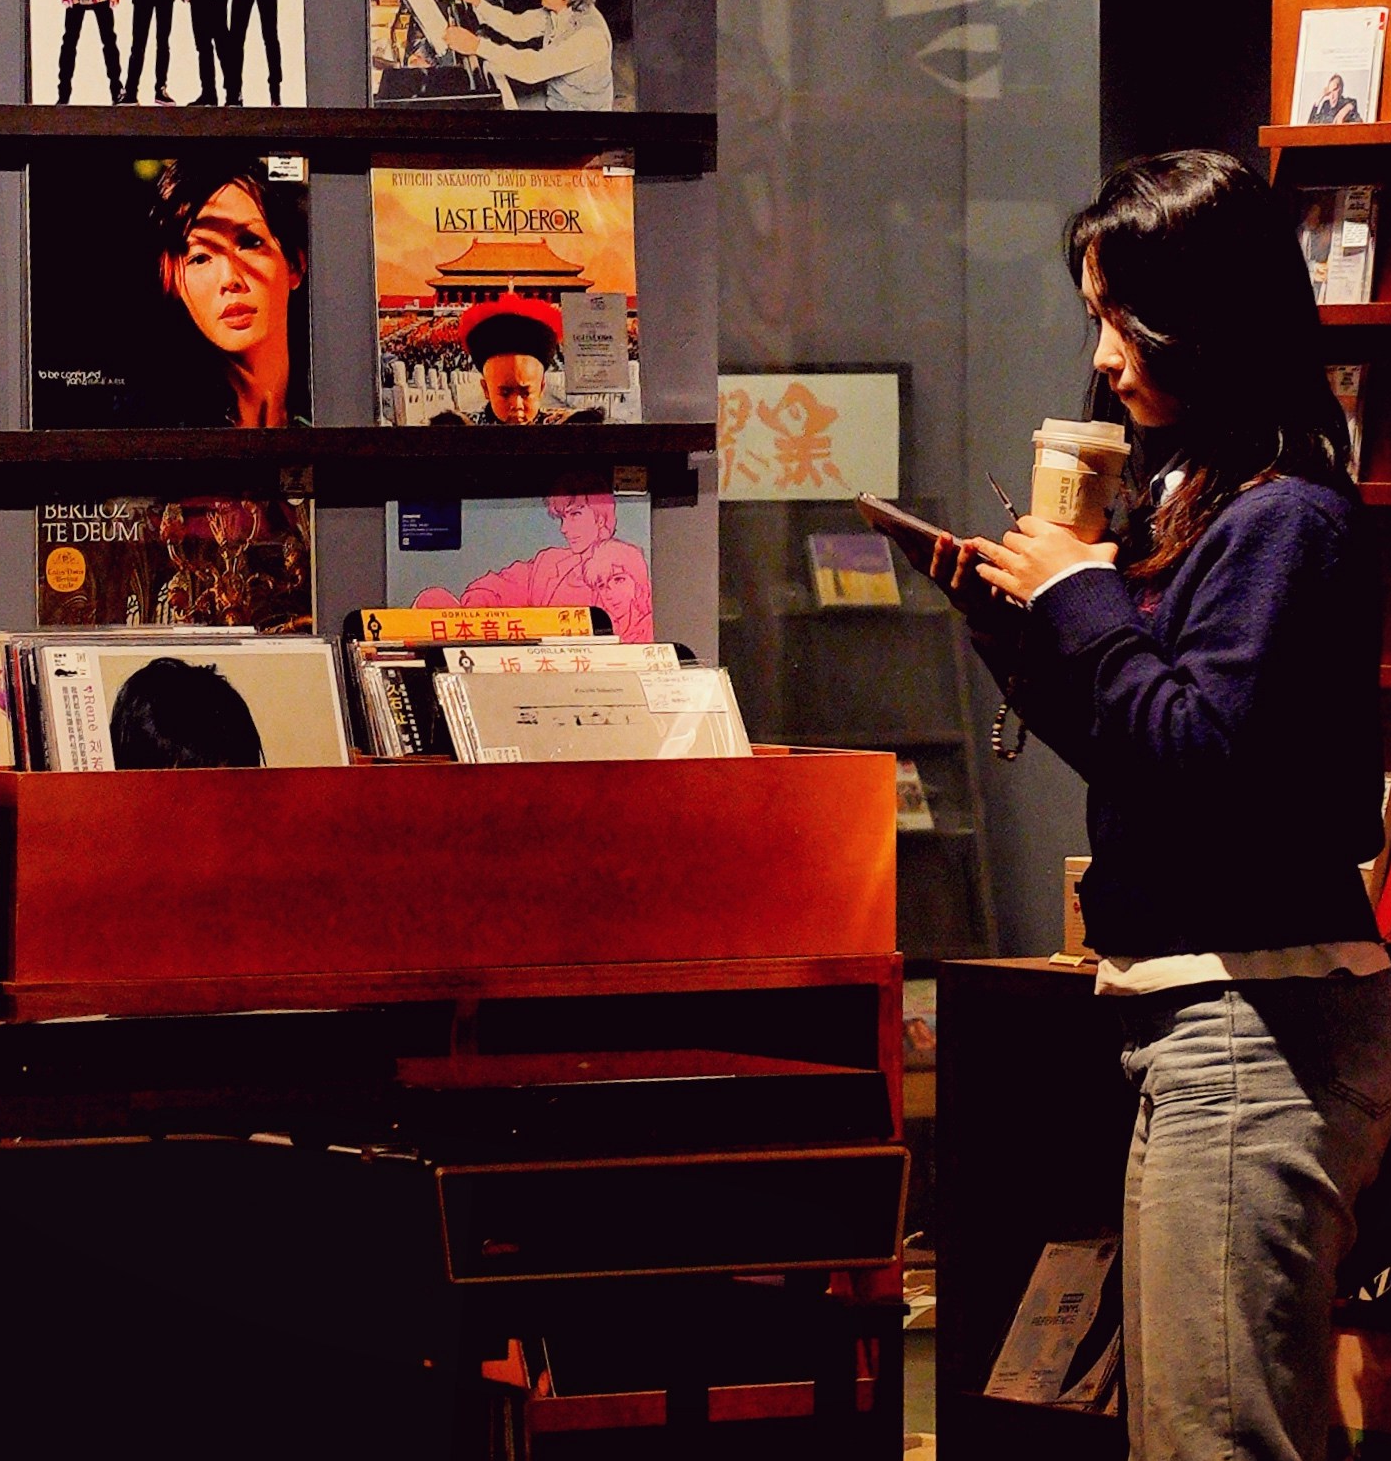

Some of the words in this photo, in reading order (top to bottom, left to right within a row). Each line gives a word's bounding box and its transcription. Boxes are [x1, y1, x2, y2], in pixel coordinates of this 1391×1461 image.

[392, 173, 433, 186] RYUICHI
[437, 174, 491, 187] SAKAMOTO
[497, 174, 527, 188] DAVID
[530, 175, 562, 188] BYRNE
[490, 189, 521, 209] THE
[435, 206, 481, 234] LAST
[483, 208, 583, 235] EMPEROR
[44, 504, 130, 519] BERLIOZ
[42, 522, 69, 543] TE
[72, 521, 139, 543] DEUM
[441, 611, 481, 619] GORILLA
[484, 611, 512, 619] VINYL
[430, 619, 527, 641] 日本音乐
[527, 647, 565, 655] GORILLA
[567, 647, 593, 655] VINYL
[499, 656, 628, 674] 坂本龙一
